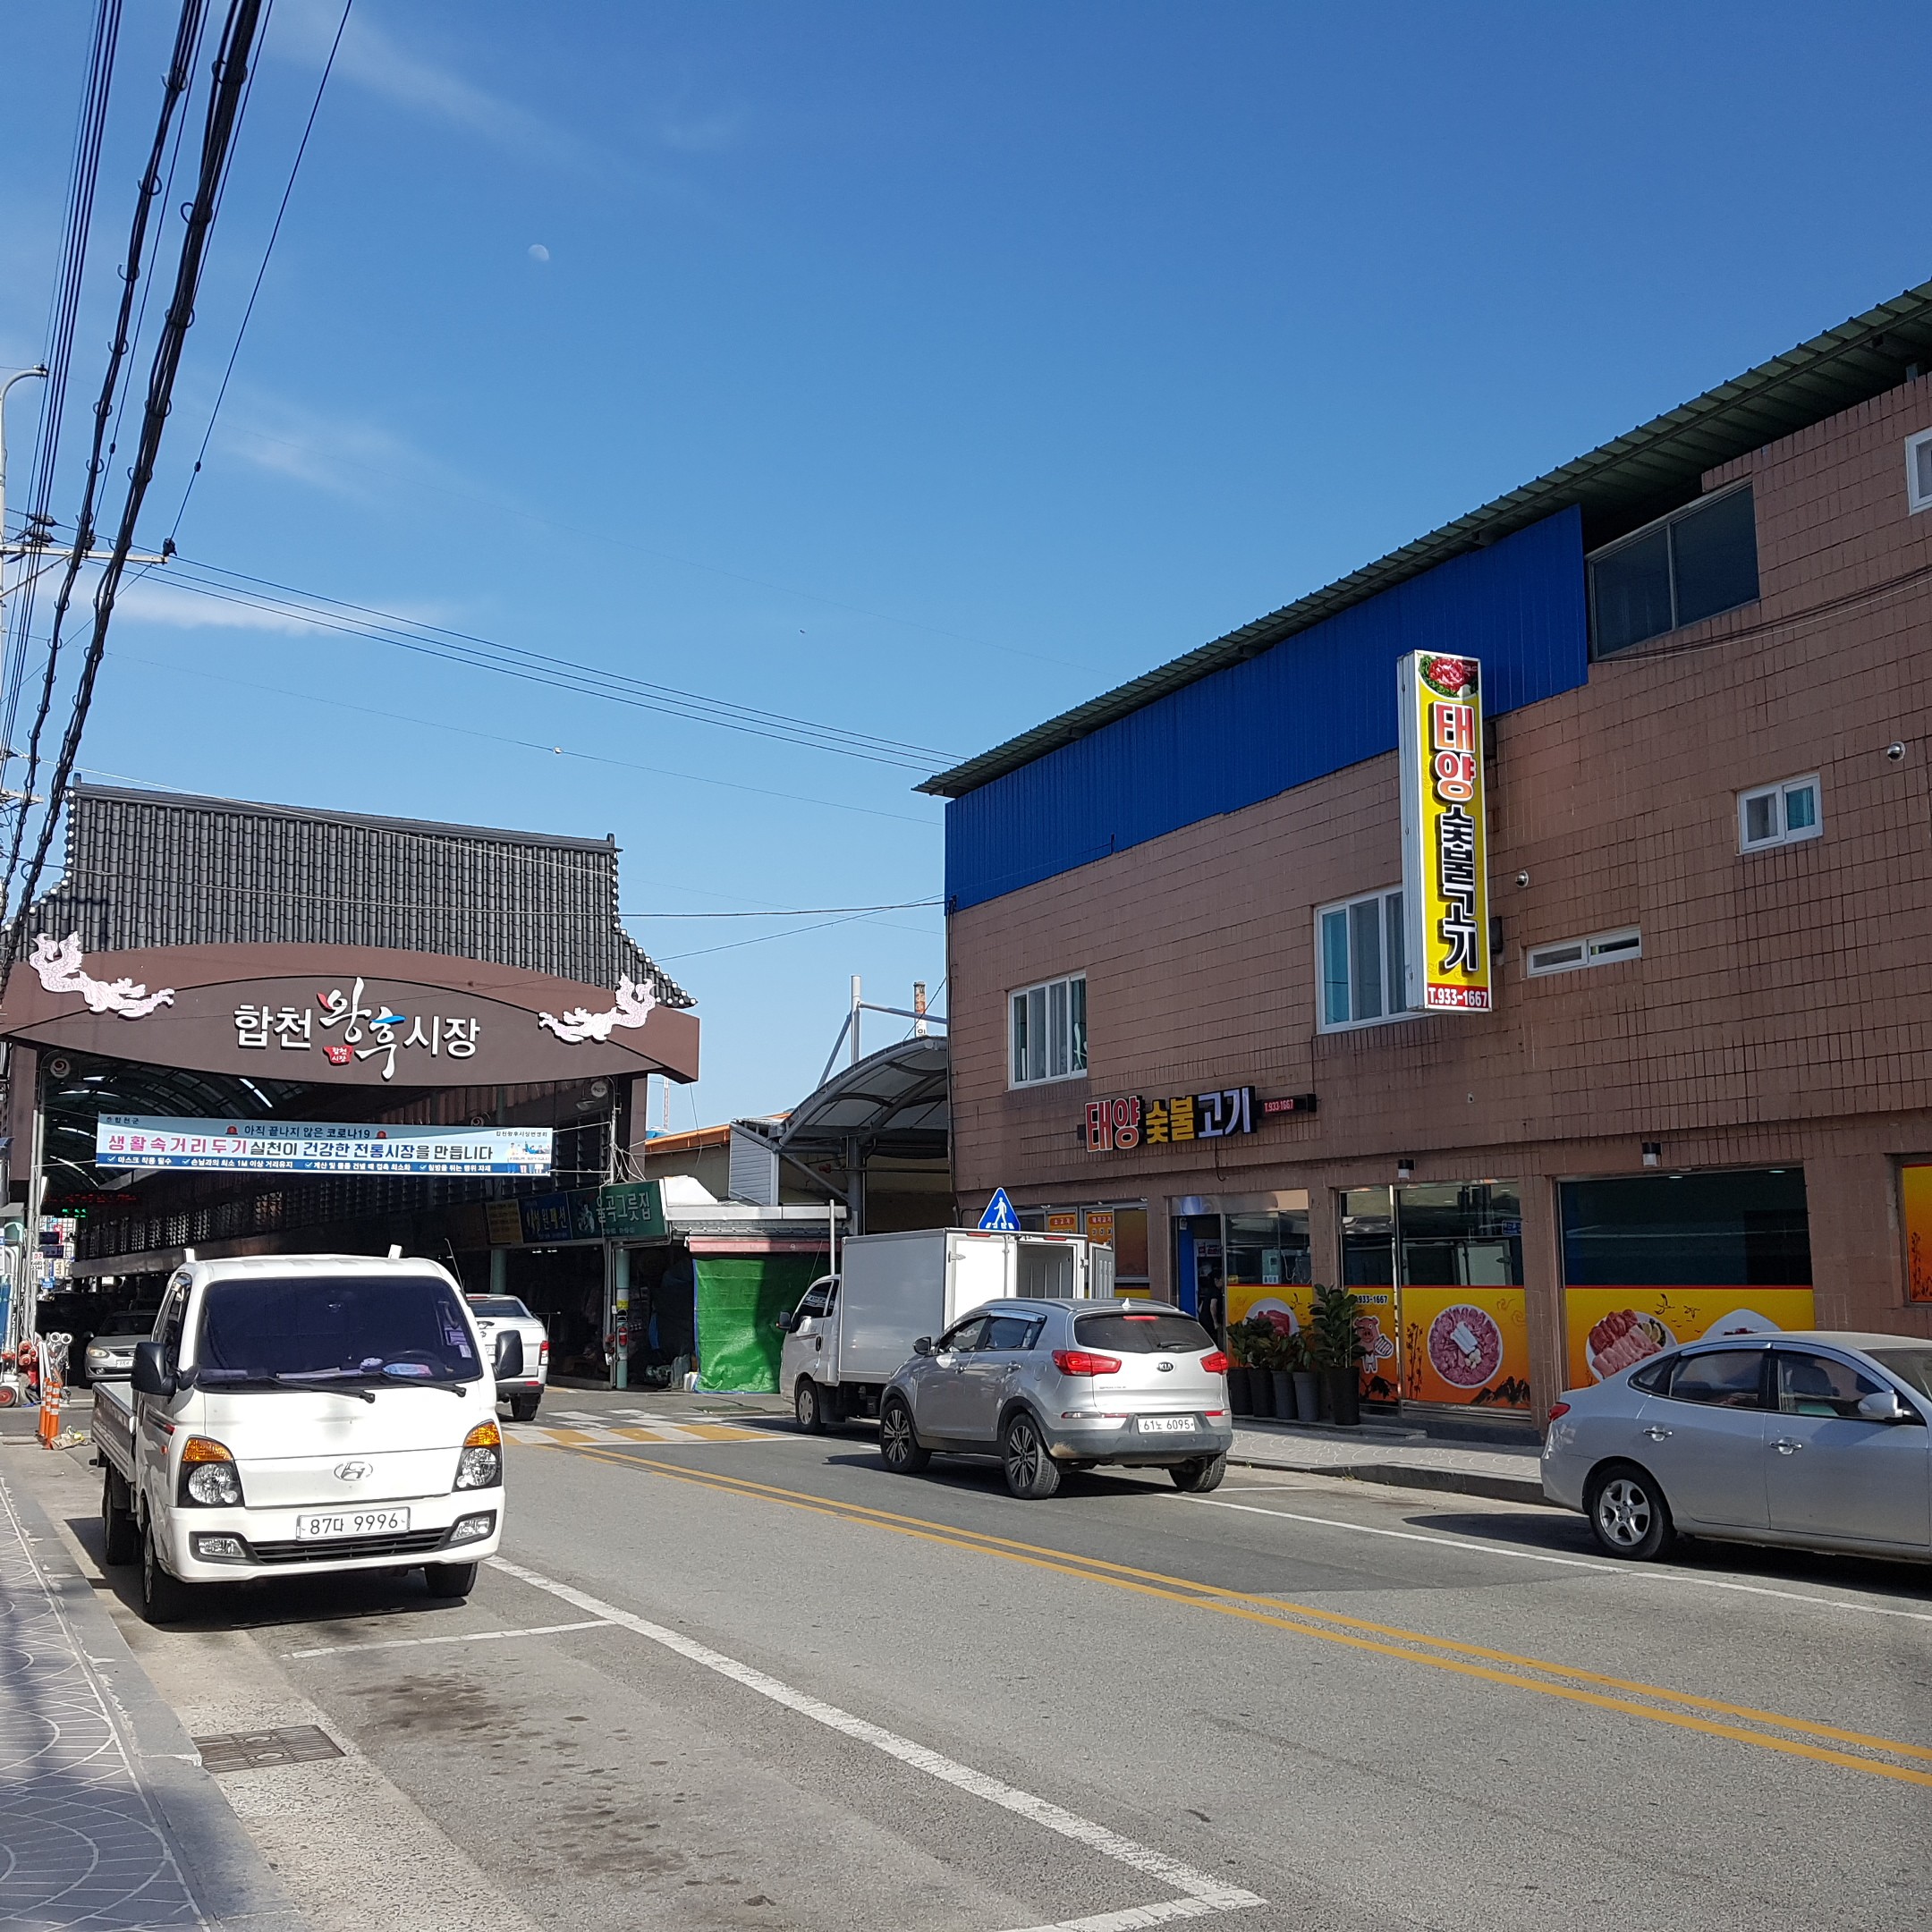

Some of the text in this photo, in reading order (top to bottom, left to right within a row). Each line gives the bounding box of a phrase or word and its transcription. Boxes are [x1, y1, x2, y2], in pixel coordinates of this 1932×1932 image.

[1434, 701, 1479, 971] 태양 숯불고기
[1428, 987, 1488, 1007] T.933-1667
[1264, 1098, 1294, 1113] T.933-1667
[244, 1124, 370, 1139] 아직 끝나지 않은 코로나19
[1085, 1095, 1140, 1152] 태양
[117, 1156, 140, 1164] 마스크
[303, 1141, 350, 1157] 건강한
[353, 1143, 430, 1159] 전통시장을
[434, 1145, 493, 1160] 만듭니다
[1144, 1419, 1191, 1431] 61노 6095
[309, 1513, 398, 1535] 87다 9996
